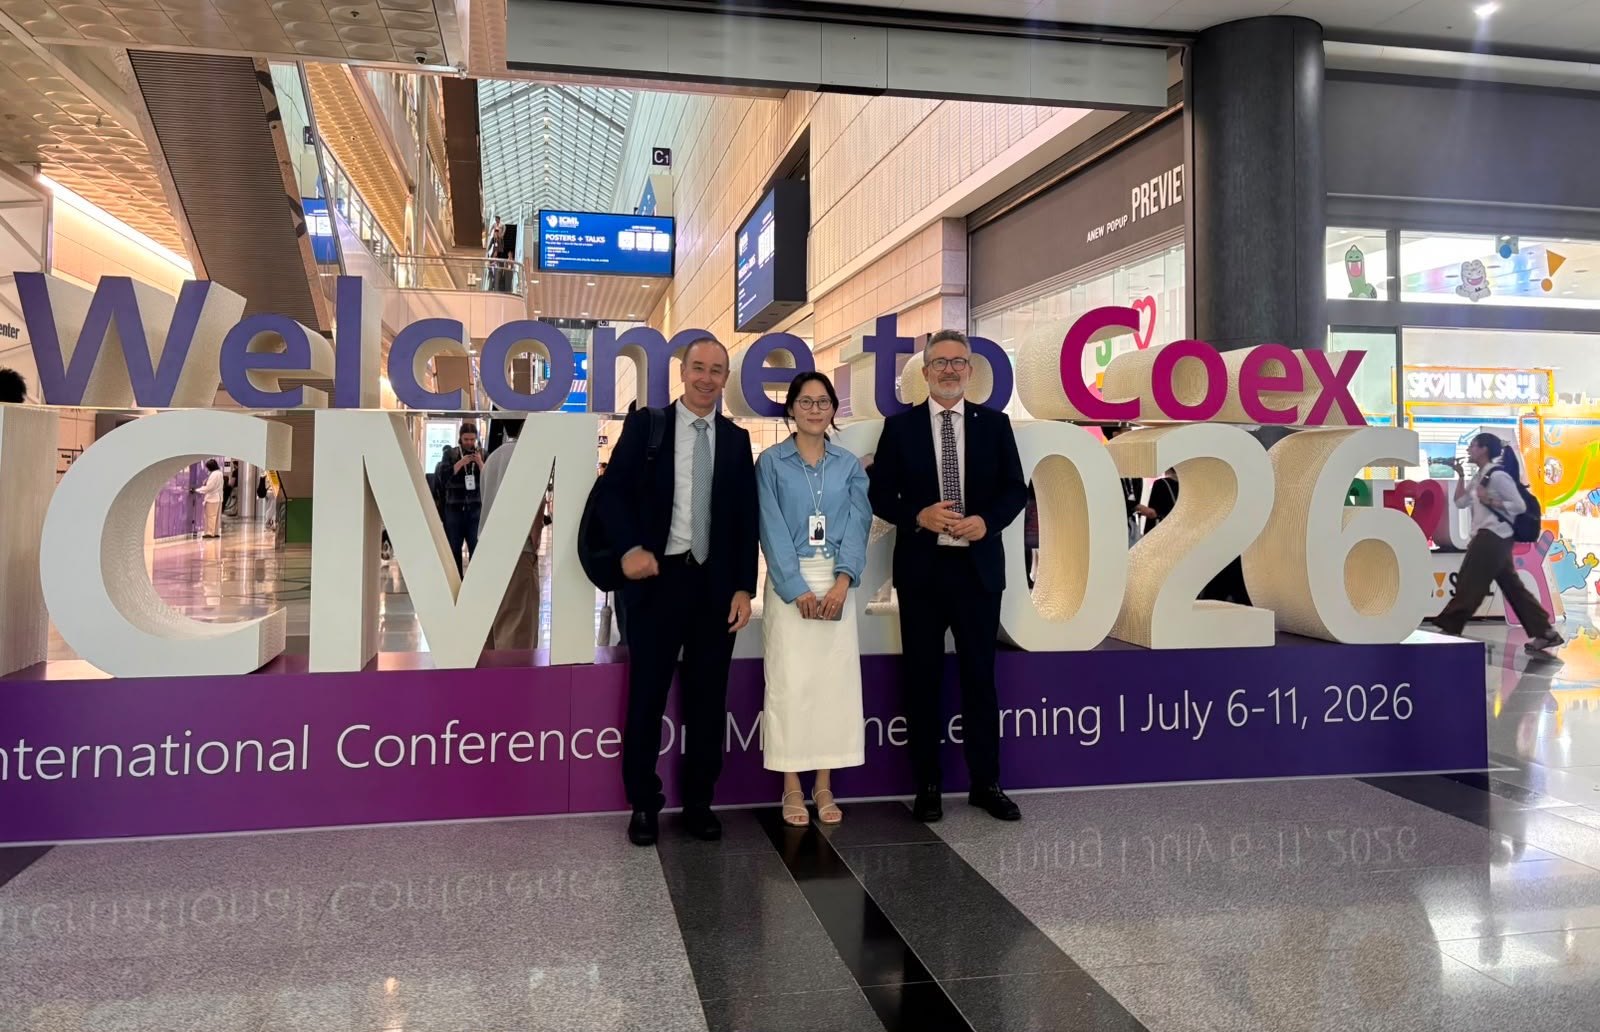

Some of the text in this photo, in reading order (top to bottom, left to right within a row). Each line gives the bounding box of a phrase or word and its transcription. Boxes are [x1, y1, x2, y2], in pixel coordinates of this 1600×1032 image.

[654, 150, 669, 164] C1
[545, 233, 576, 242] POSTERS
[585, 235, 606, 243] TALKS
[1086, 225, 1105, 243] ANEW
[1106, 214, 1128, 235] POPUP
[14, 271, 816, 418] Welcome
[1060, 306, 1367, 426] Coex
[337, 719, 622, 768] Conference
[1141, 689, 1214, 741] July
[1227, 686, 1308, 730] 6-11,
[1323, 682, 1414, 723] 2026
